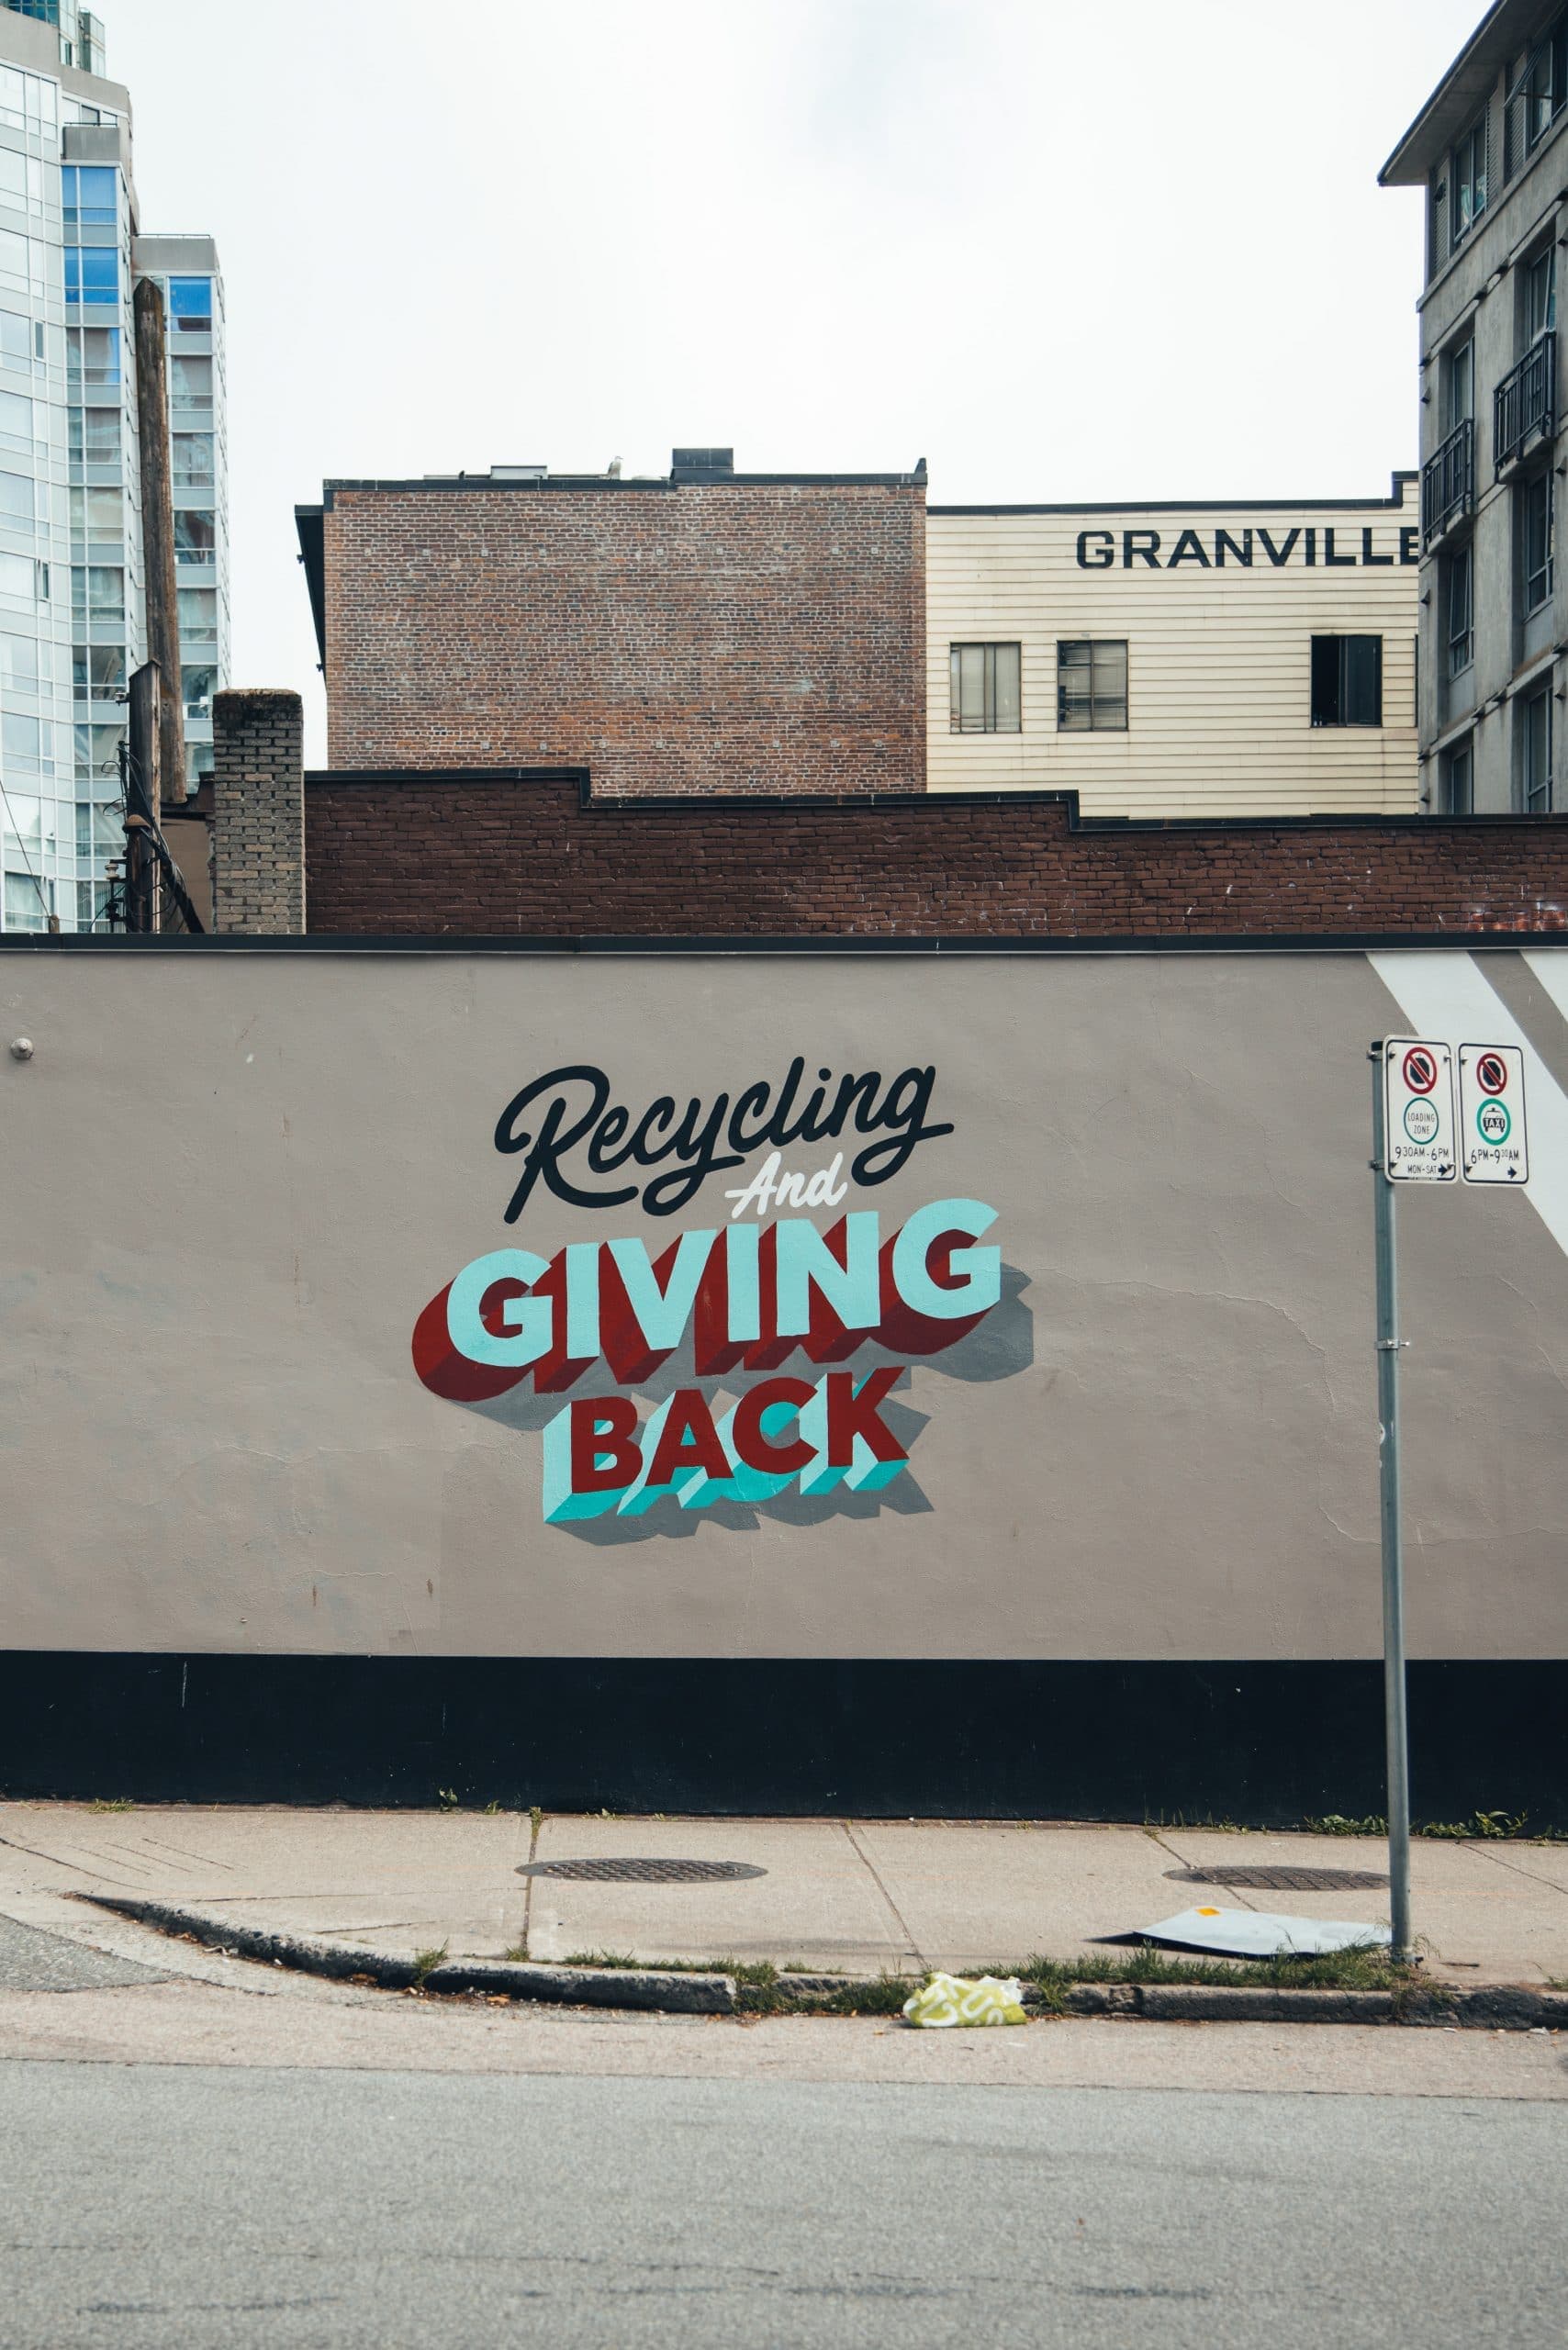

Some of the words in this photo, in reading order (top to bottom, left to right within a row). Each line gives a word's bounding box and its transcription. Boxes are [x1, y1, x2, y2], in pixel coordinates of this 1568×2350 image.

[1076, 527, 1419, 569] GRANVILLE
[494, 1057, 955, 1225] Recycling
[1407, 1112, 1436, 1123] LOADING
[1414, 1125, 1431, 1136] ZONE
[1485, 1118, 1505, 1128] TAXI
[724, 1151, 848, 1219] And
[446, 1198, 1002, 1368] GIVING
[570, 1366, 911, 1494] BACK
